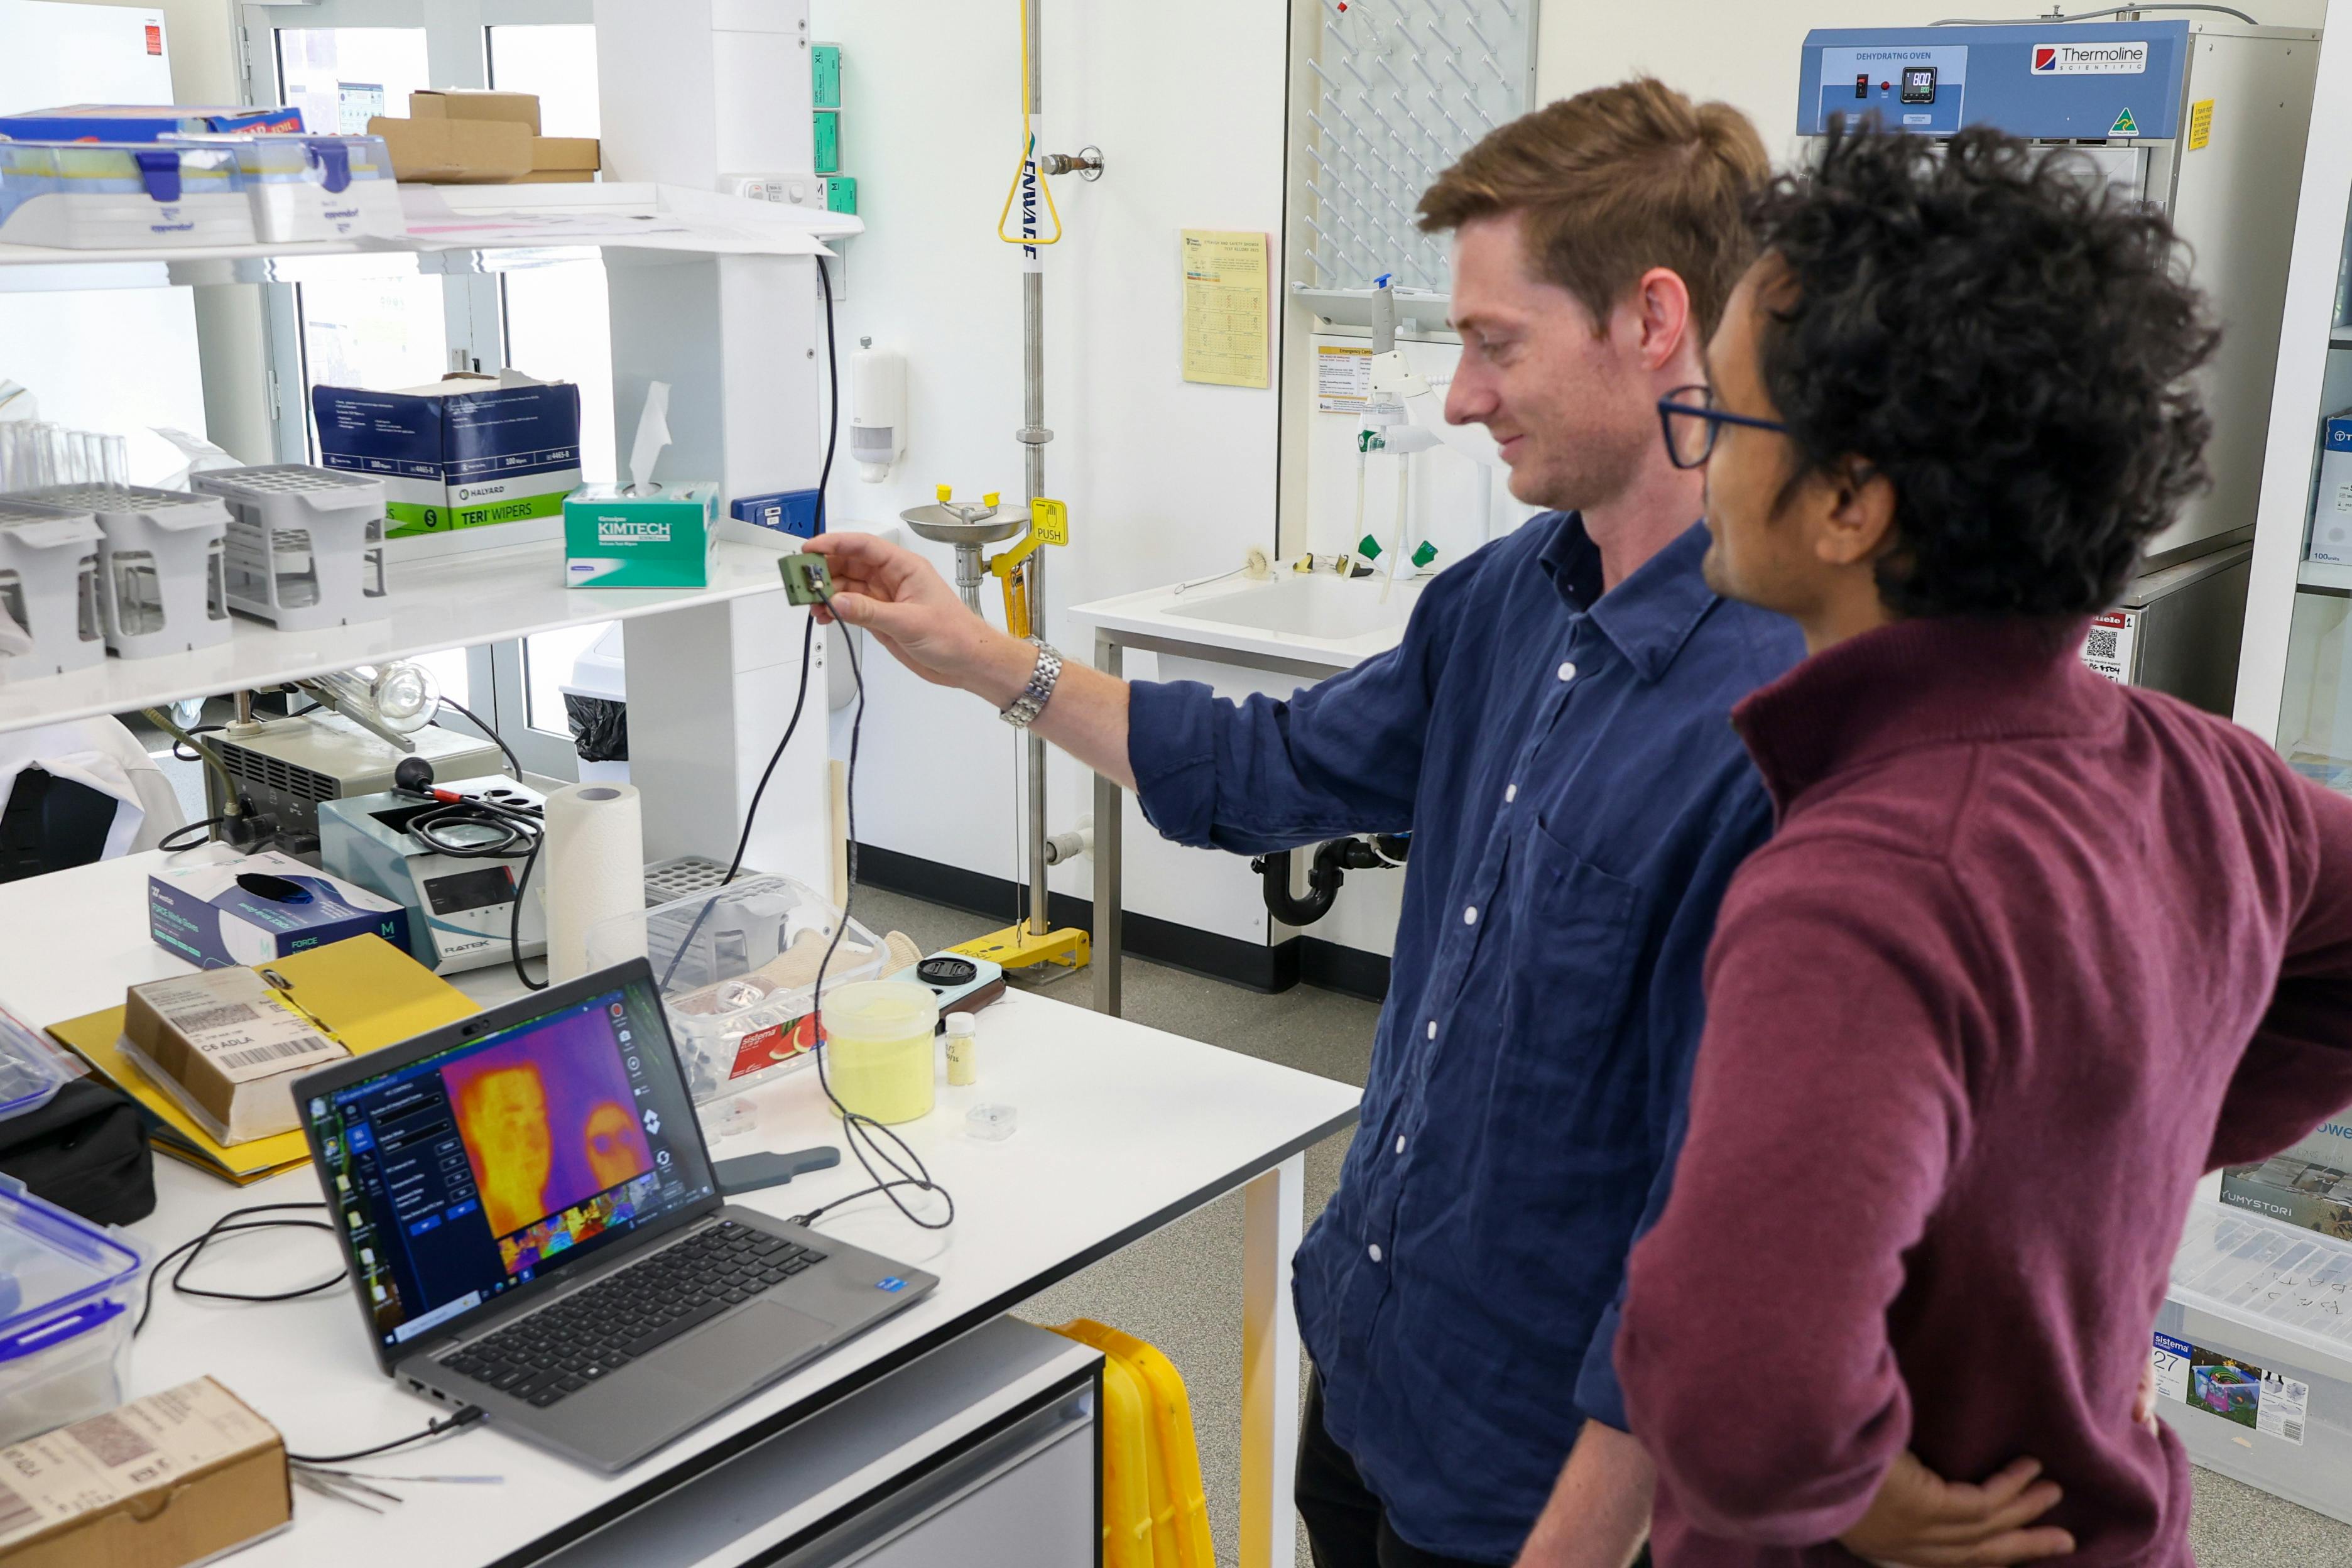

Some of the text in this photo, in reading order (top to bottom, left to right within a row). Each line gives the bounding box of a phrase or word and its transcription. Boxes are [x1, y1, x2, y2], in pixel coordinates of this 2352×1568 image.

[815, 52, 821, 63] XL
[2062, 47, 2143, 61] Thermoline
[325, 209, 359, 219] eppendorf
[506, 457, 516, 466] 100
[471, 487, 504, 497] HALYARD
[461, 503, 531, 525] TERI WIPERS
[598, 523, 670, 535] KIMTECH
[1038, 528, 1060, 541] PUSH
[2126, 618, 2133, 628] 1
[381, 921, 395, 936] M
[291, 937, 318, 949] FORCE
[445, 940, 490, 954] RATEK
[221, 1037, 256, 1048] ADLA
[743, 1028, 776, 1045] sistema
[2221, 1190, 2292, 1217] YUMYSTORI
[2155, 1336, 2189, 1353] sistema
[2153, 1351, 2179, 1371] 27
